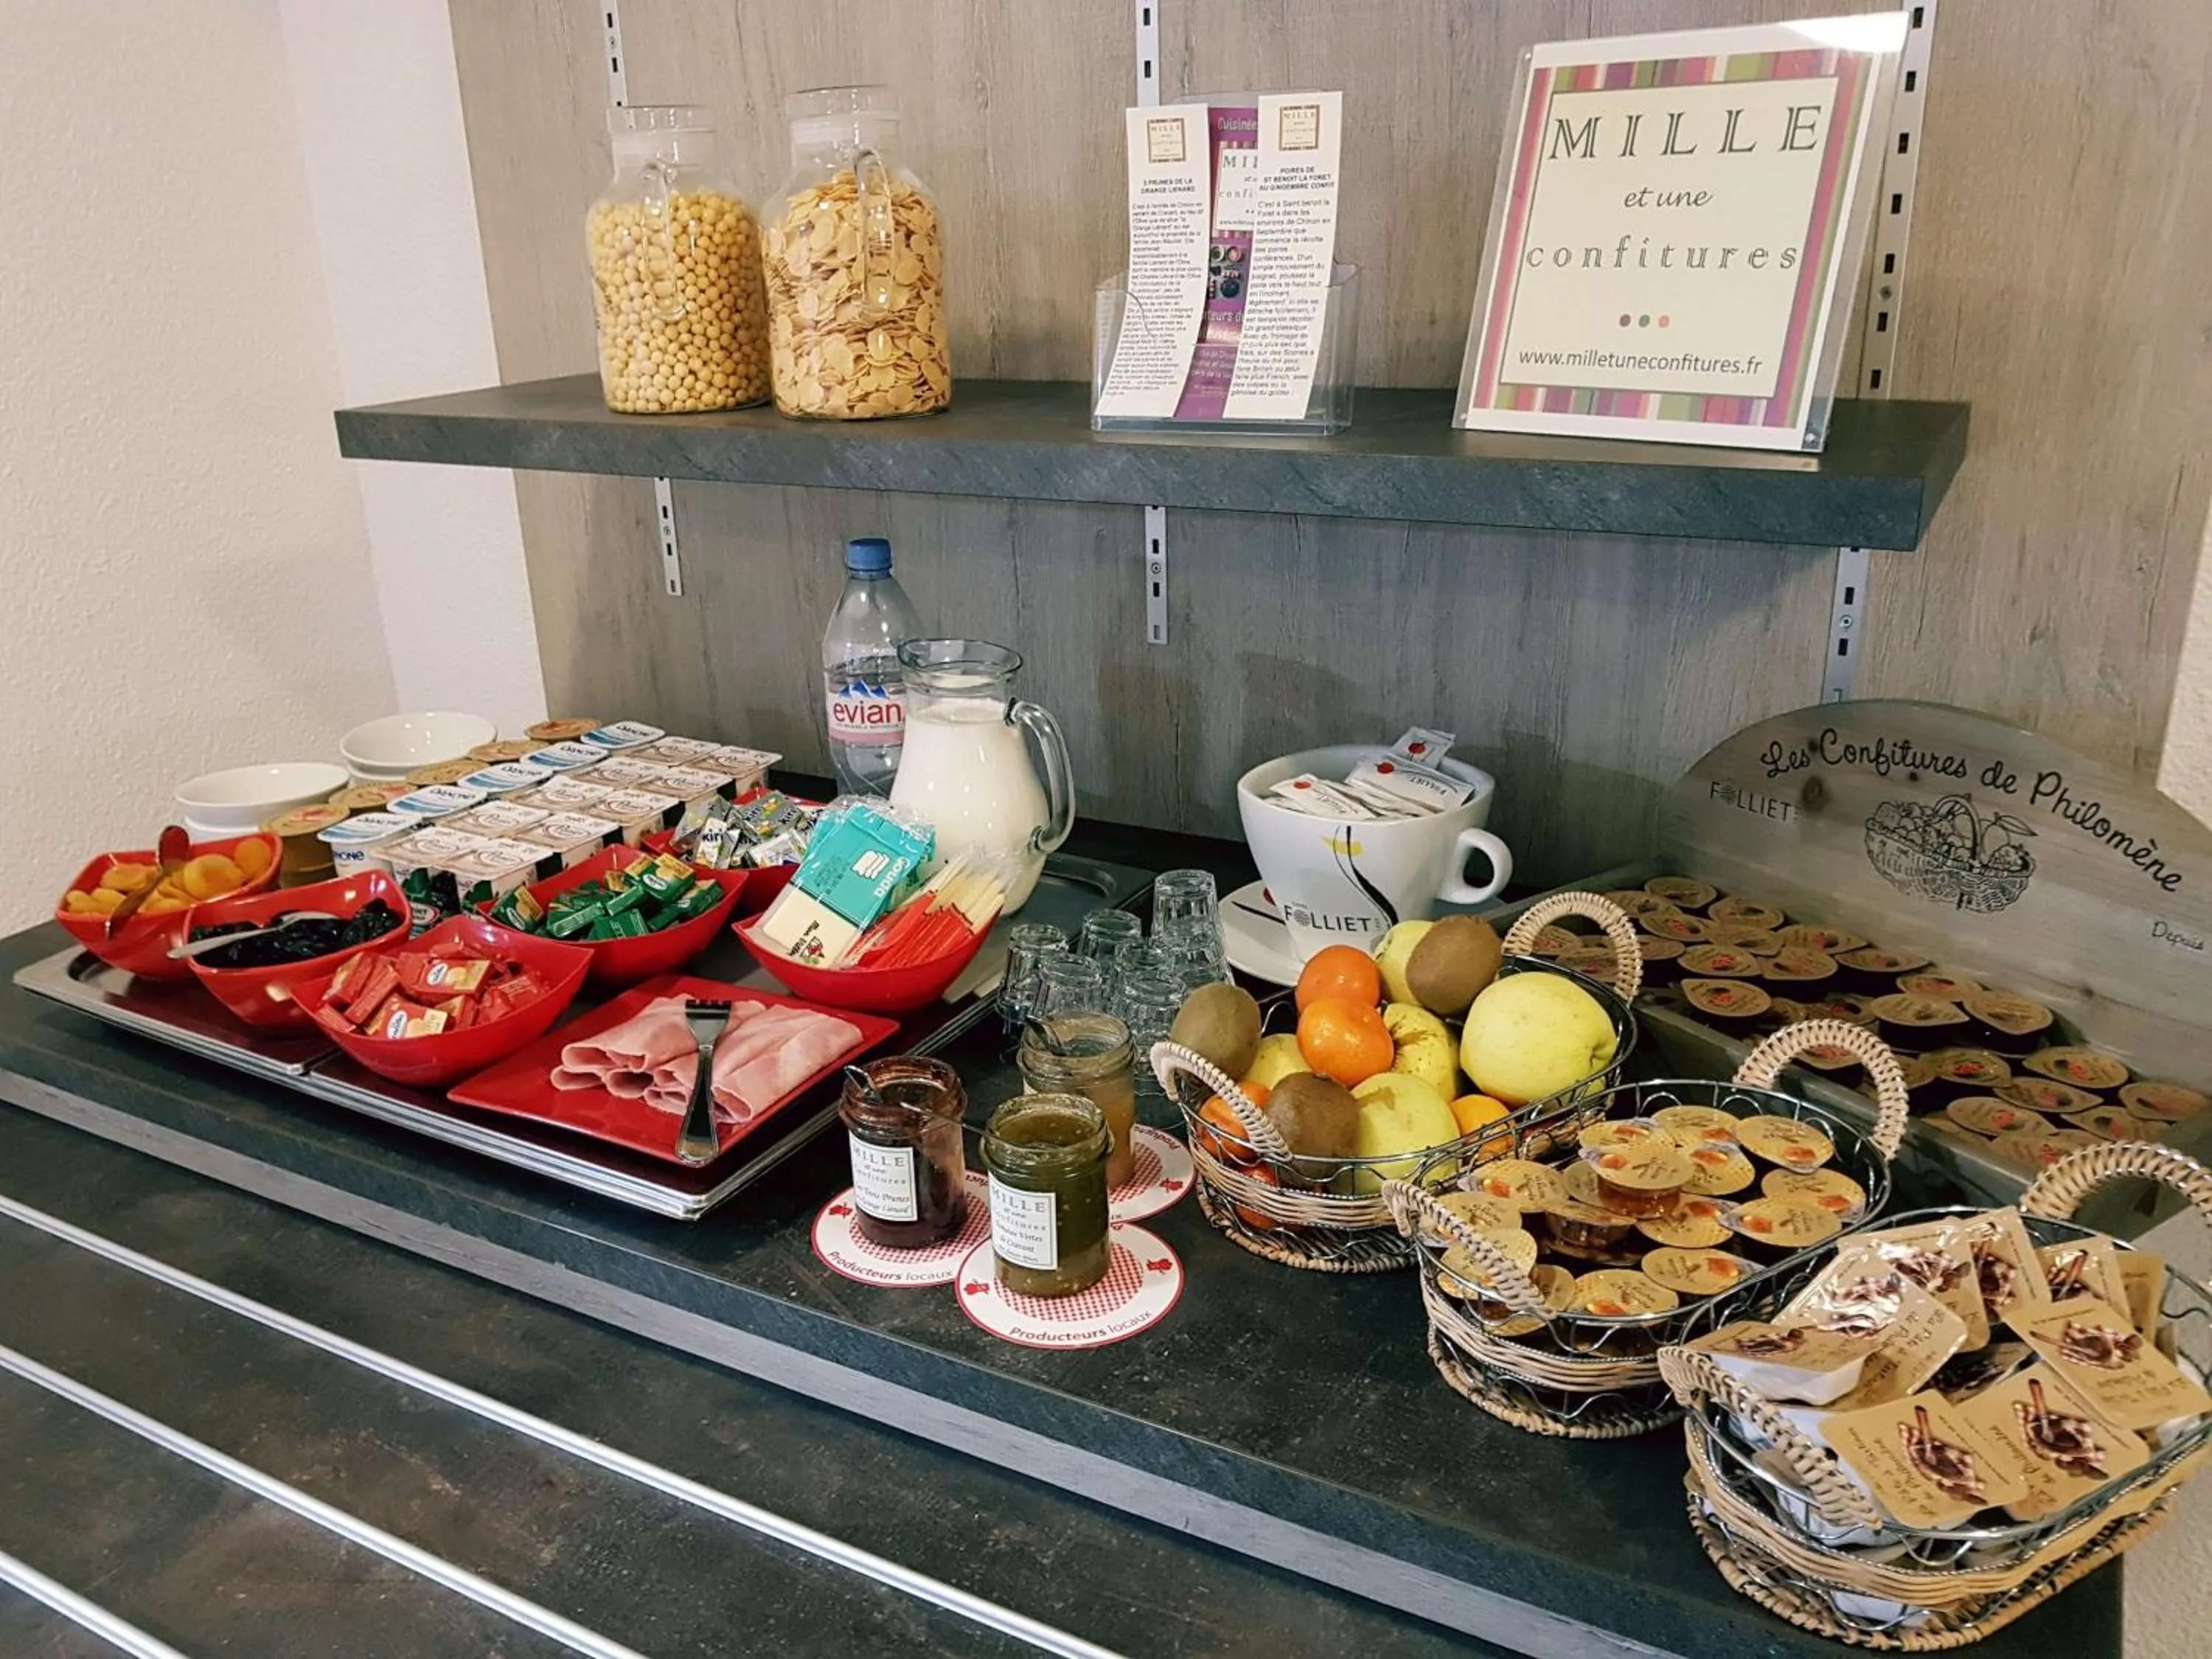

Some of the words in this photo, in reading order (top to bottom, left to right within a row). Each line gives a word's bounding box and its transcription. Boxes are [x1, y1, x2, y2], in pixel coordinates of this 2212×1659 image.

[1547, 105, 1823, 160] MILLE
[1624, 186, 1652, 209] et
[1656, 188, 1715, 208] une
[1526, 234, 1798, 271] confitures
[1518, 349, 1763, 377] www.milletuneconfitures.fr
[1760, 740, 1812, 778] Les
[1818, 727, 1969, 779] Confitures
[1980, 760, 2018, 796] de
[2029, 770, 2184, 894] Philomène
[702, 828, 724, 843] kiri
[826, 1250, 903, 1281] Producteurs
[905, 1270, 954, 1281] locaux
[1008, 1326, 1107, 1342] Producteurs
[1106, 1310, 1153, 1335] locaux
